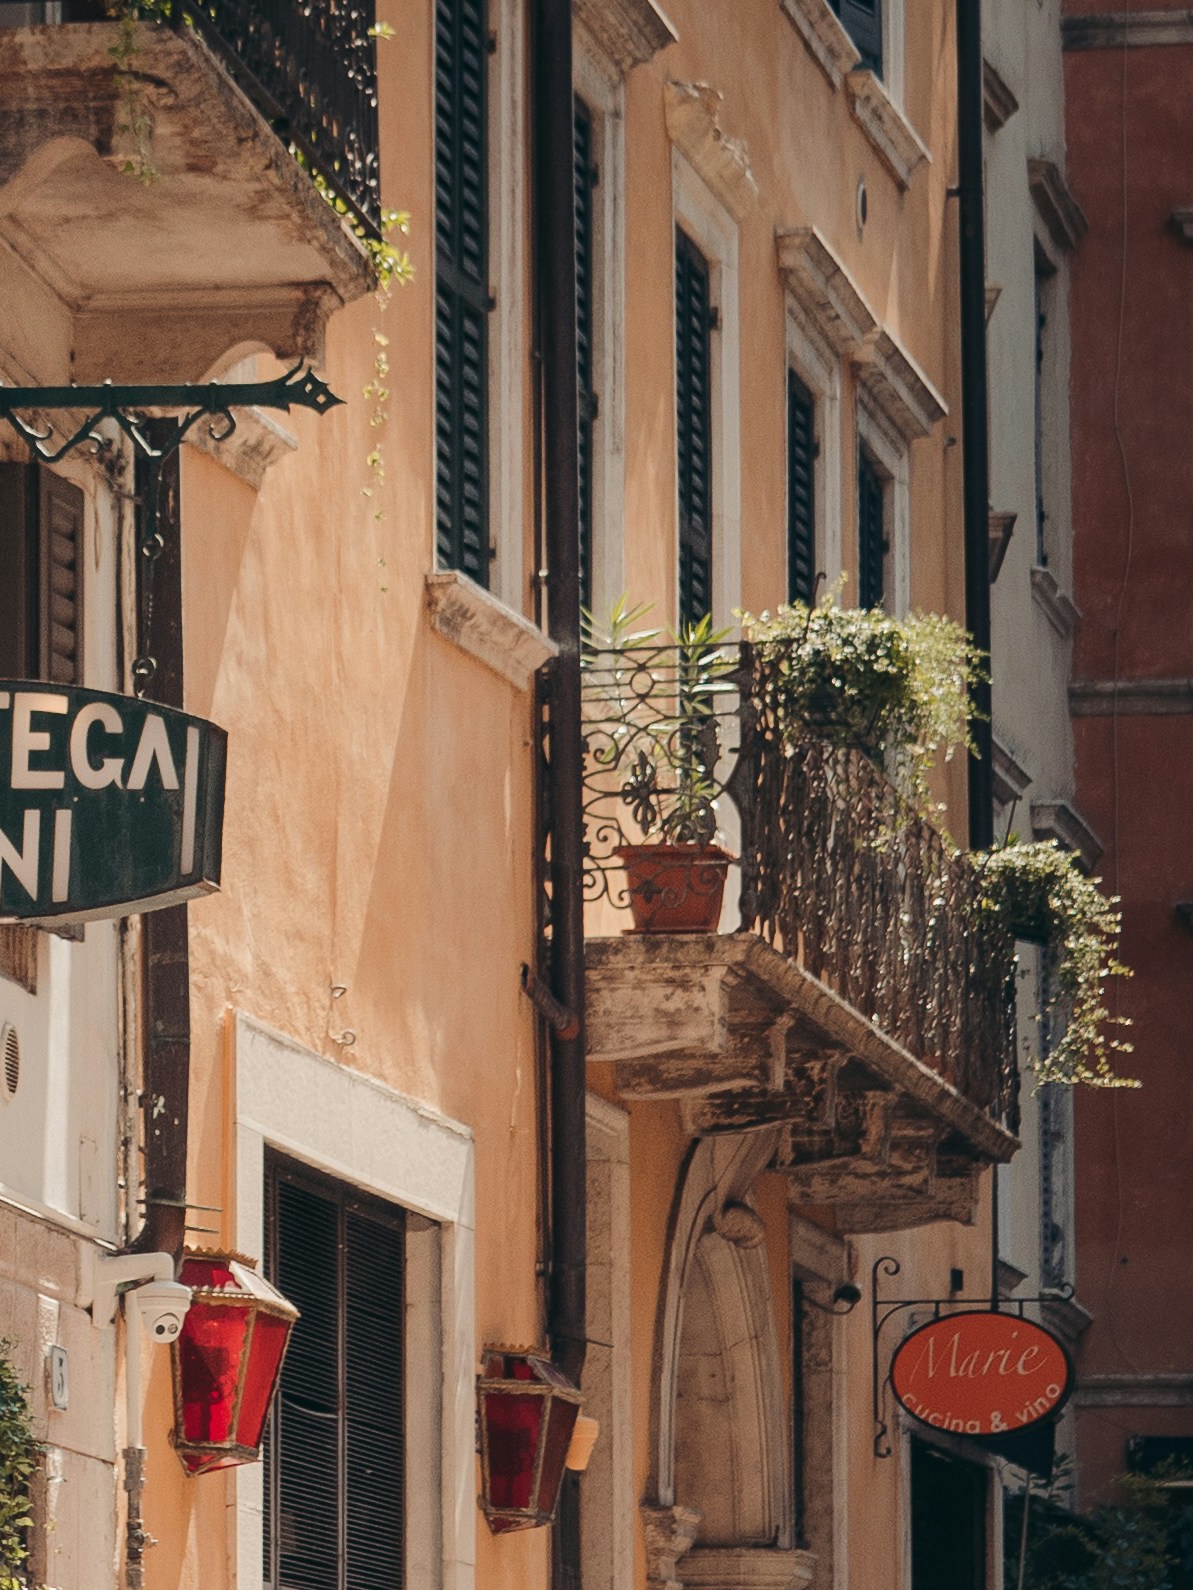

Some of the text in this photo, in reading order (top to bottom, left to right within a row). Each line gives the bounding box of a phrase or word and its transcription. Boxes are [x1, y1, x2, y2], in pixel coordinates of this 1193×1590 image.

[909, 1331, 1048, 1383] Marie
[901, 1383, 1061, 1435] cucina & vino
